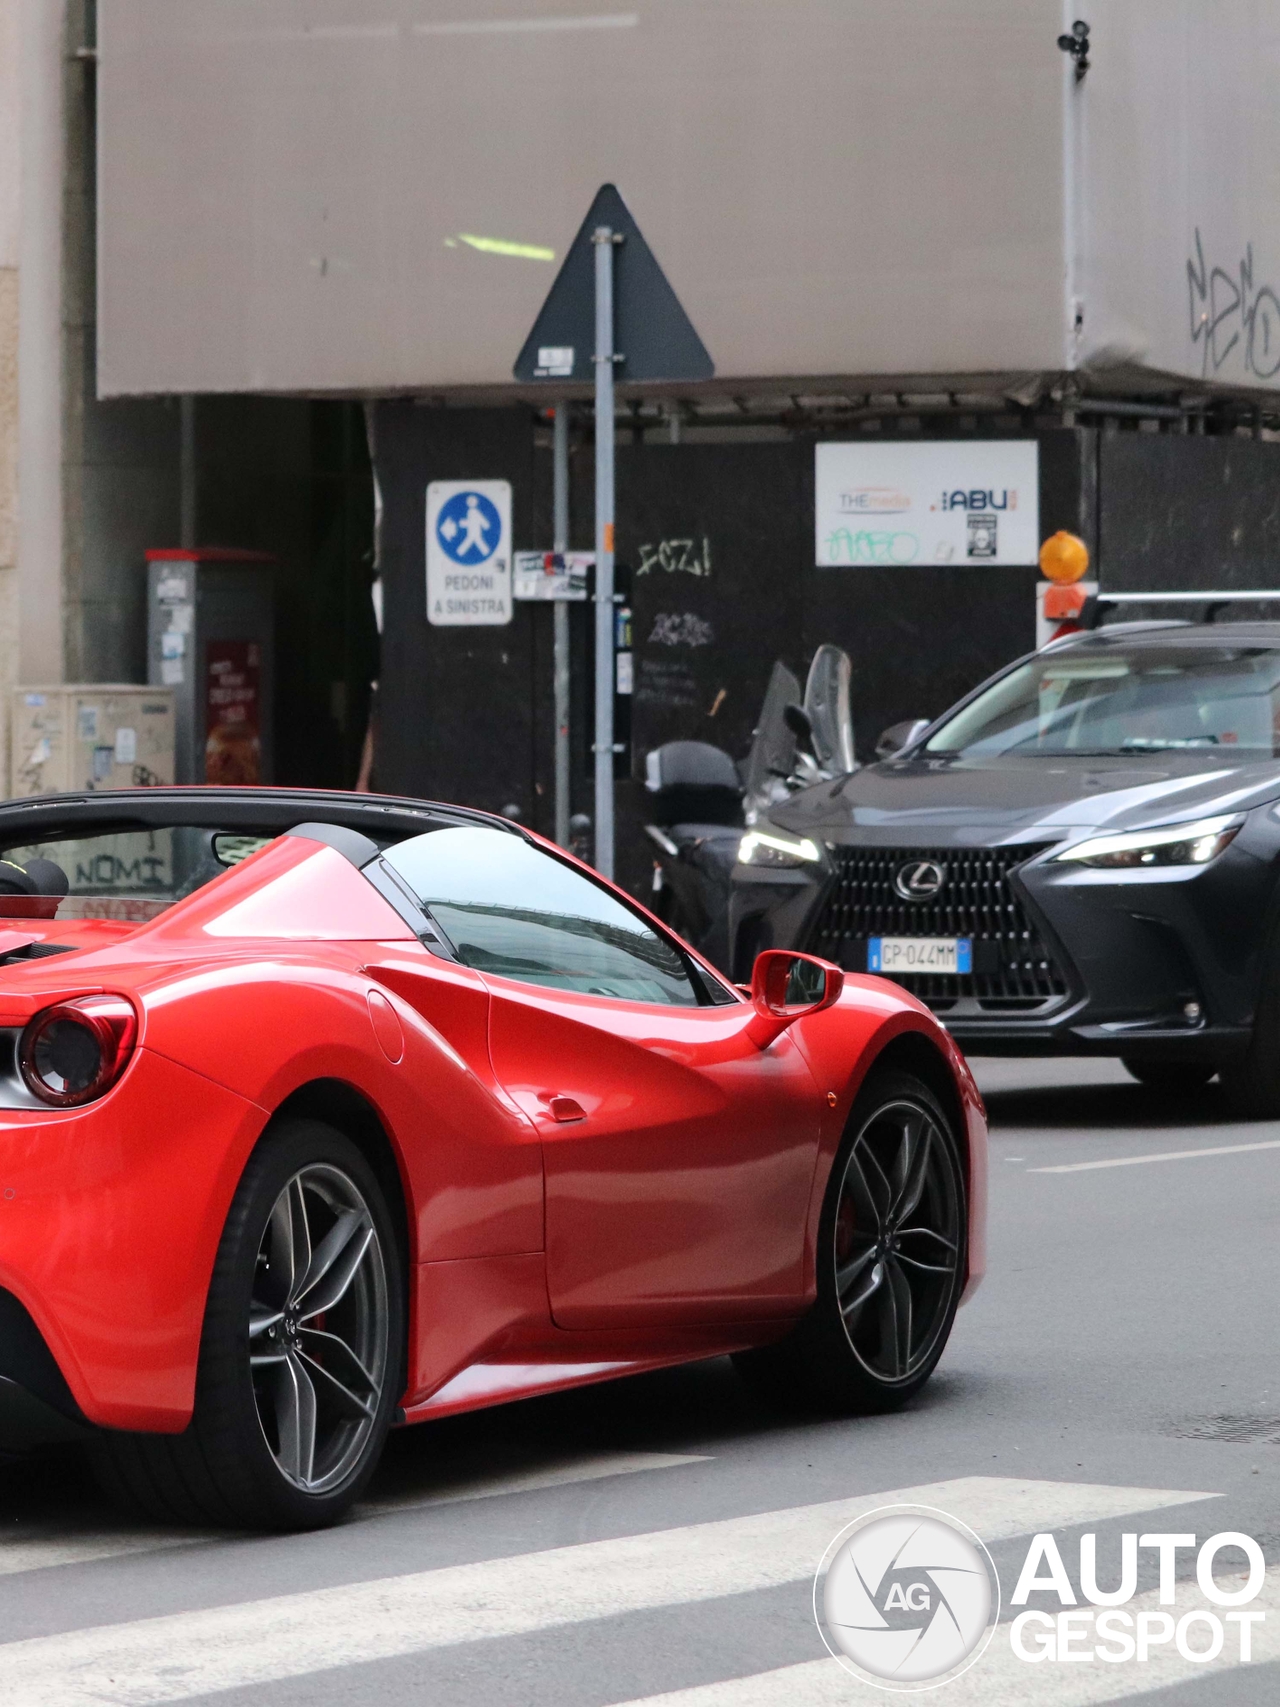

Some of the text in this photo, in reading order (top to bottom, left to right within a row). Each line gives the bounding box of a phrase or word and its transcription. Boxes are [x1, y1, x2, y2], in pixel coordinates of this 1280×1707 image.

[444, 575, 494, 591] PEDONI
[434, 599, 505, 615] A SINISTRA
